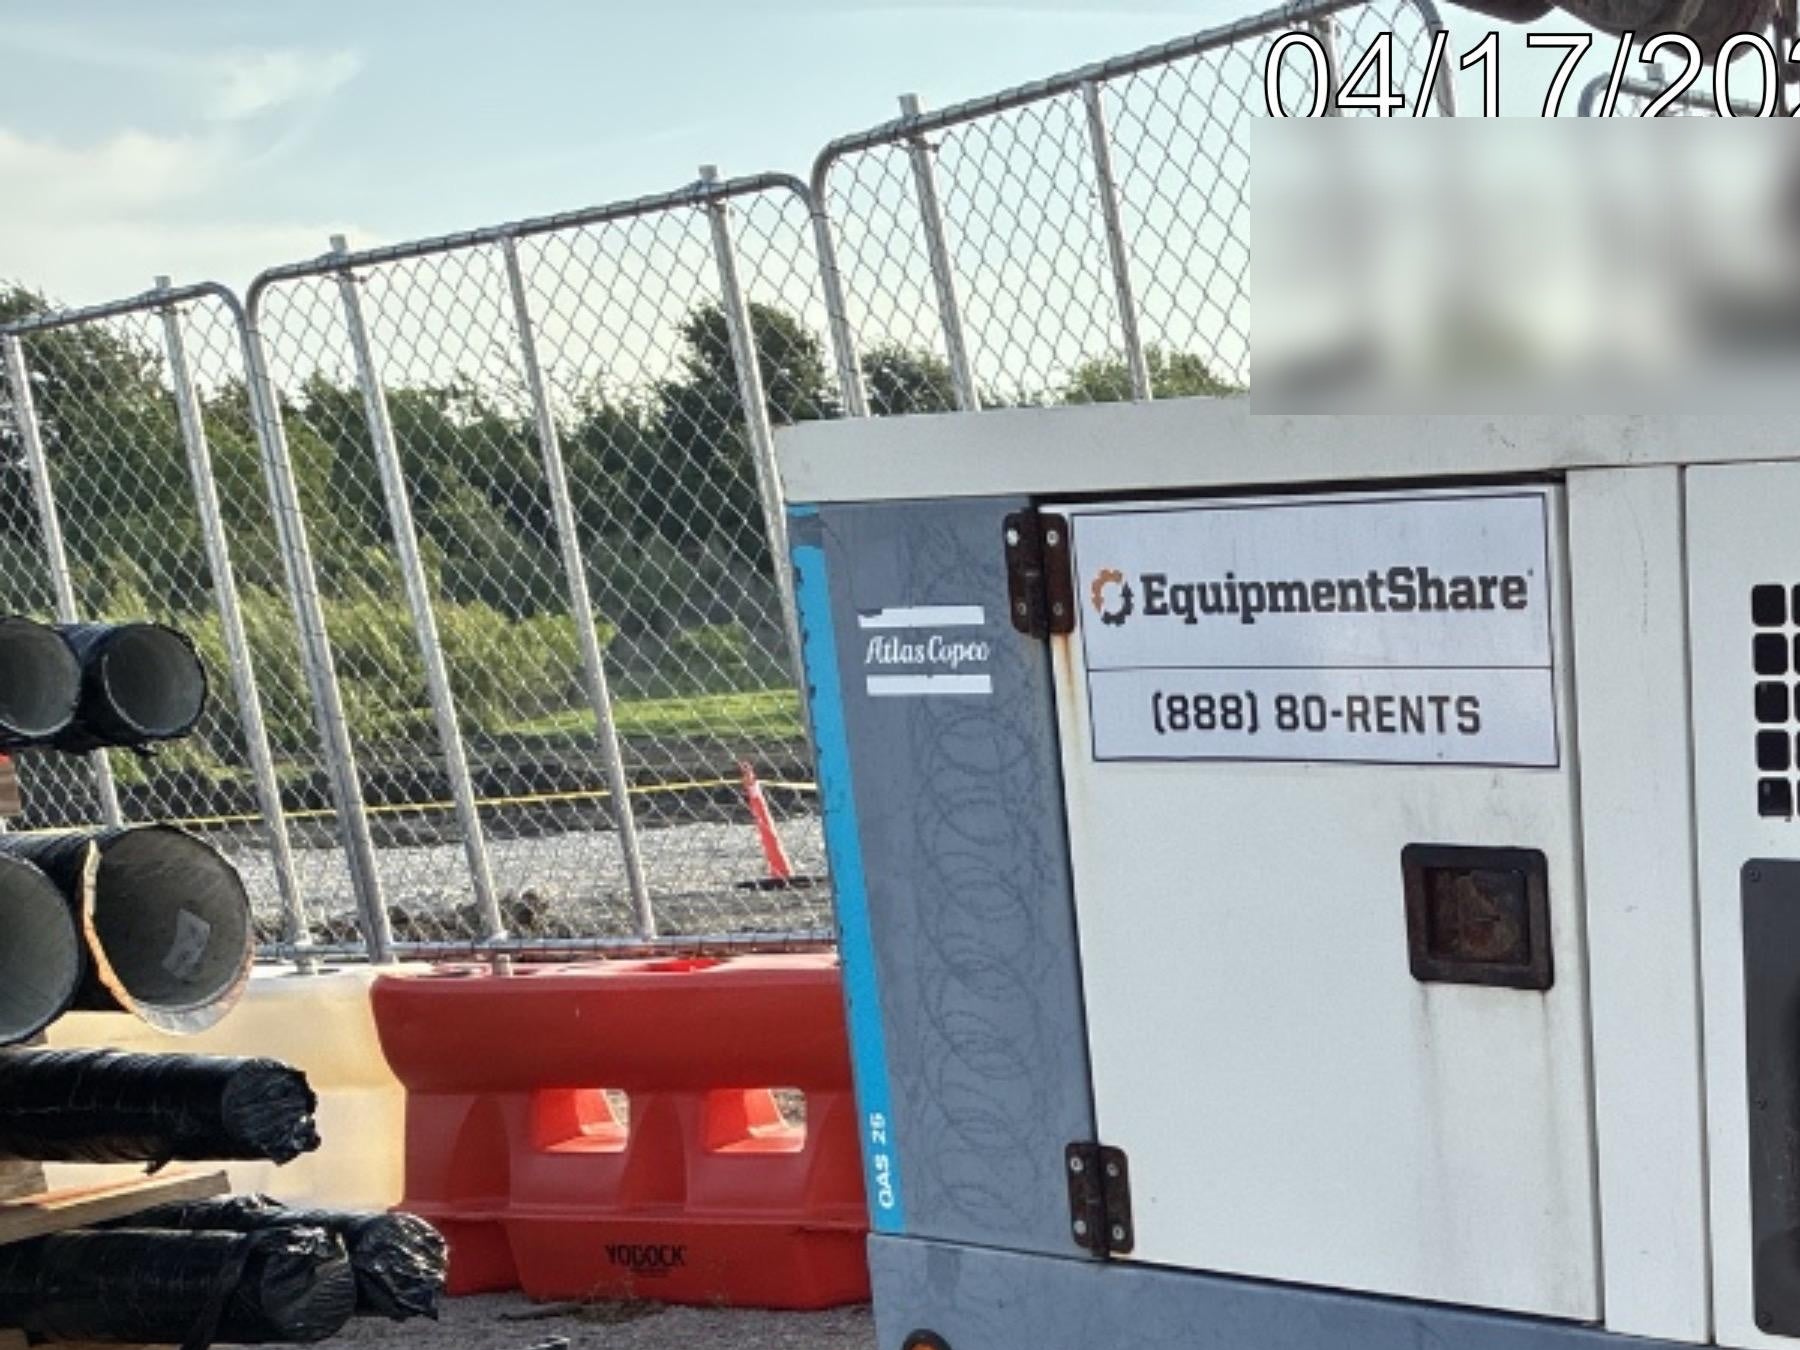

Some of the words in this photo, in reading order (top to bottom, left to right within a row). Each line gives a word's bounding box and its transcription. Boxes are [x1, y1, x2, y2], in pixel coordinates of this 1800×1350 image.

[1140, 566, 1529, 625] EquipmentShare
[865, 635, 925, 664] Atlas
[927, 635, 990, 669] Copco
[1152, 689, 1258, 735] (888)
[1274, 694, 1480, 735] 80-RENTS
[604, 1243, 688, 1267] YODOCK
